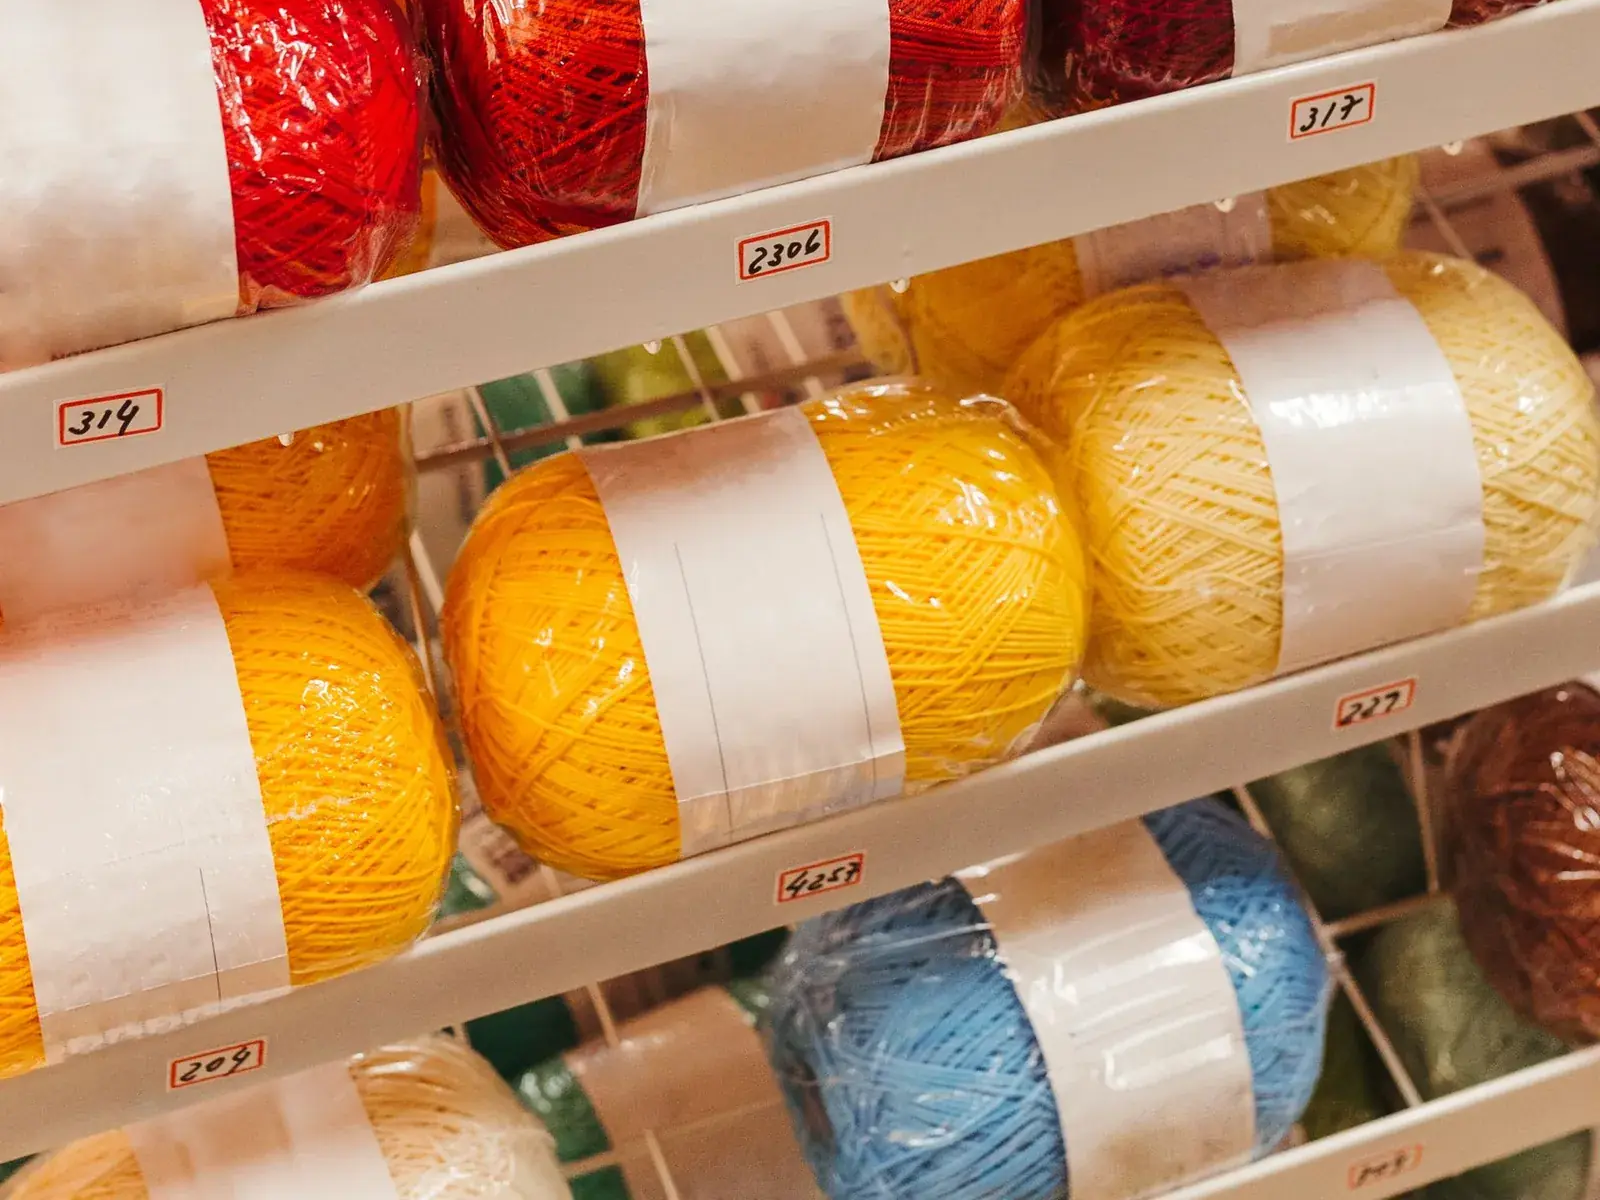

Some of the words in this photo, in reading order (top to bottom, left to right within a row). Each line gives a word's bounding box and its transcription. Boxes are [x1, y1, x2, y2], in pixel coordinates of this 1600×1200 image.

[1299, 94, 1364, 132] 317
[748, 228, 822, 275] 2306
[68, 399, 140, 437] 314
[785, 862, 861, 899] 4257
